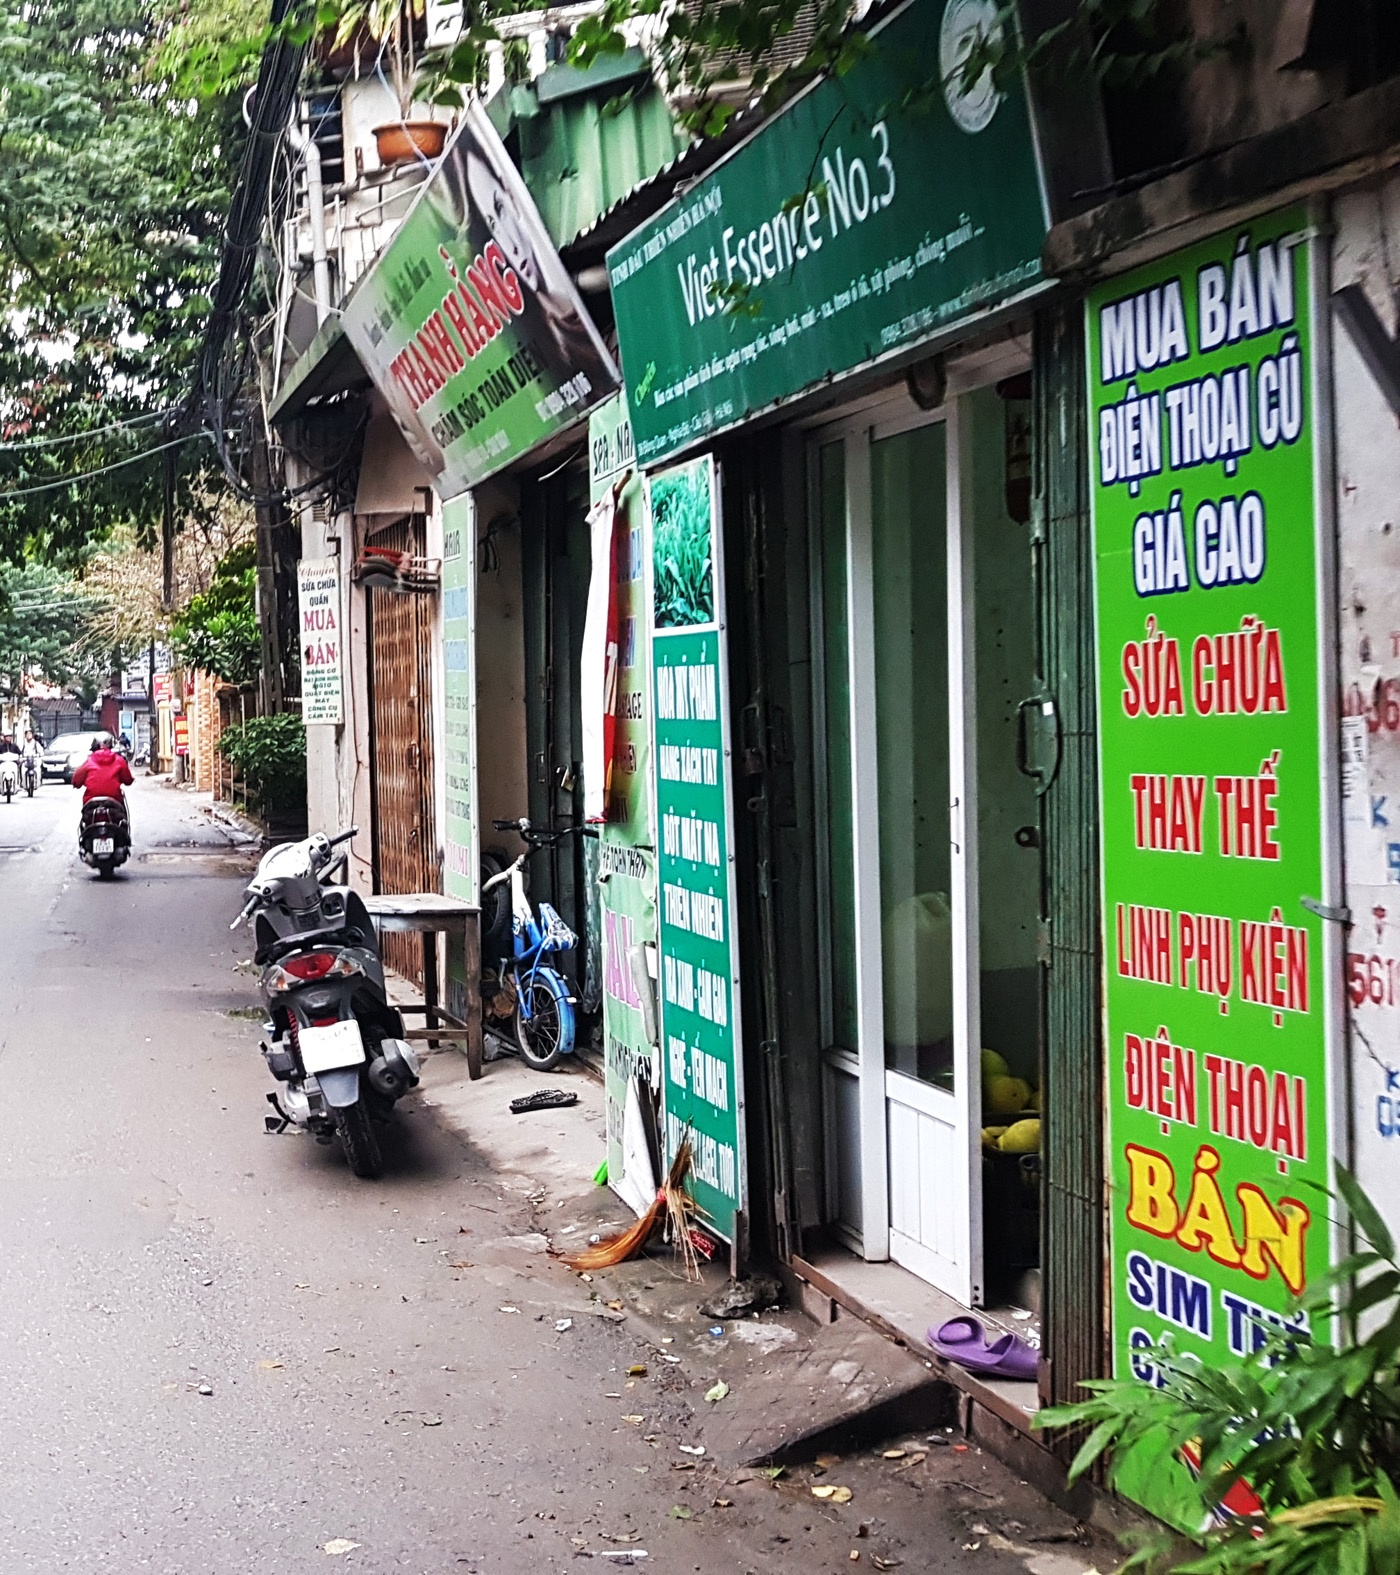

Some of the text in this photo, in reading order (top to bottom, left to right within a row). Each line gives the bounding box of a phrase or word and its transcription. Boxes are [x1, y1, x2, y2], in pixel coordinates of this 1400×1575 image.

[677, 246, 725, 327] Viet
[822, 120, 896, 239] No.3
[1101, 278, 1189, 385] MUA
[1198, 232, 1297, 354] BÁN
[389, 309, 467, 412] THANH
[457, 392, 486, 430] SÓC
[478, 365, 517, 412] TOÀN
[1100, 382, 1162, 496] ĐIỆN
[1165, 364, 1251, 476] THOẠI
[1133, 489, 1266, 598] GIÁ CAO
[303, 608, 336, 632] MUA
[304, 637, 335, 666] BÁN
[1122, 614, 1184, 718] SỬA
[1192, 614, 1288, 716] CHỮA
[688, 640, 716, 720] PHẨM
[702, 747, 717, 785] TAY
[1130, 750, 1281, 861] THAY THẾ
[681, 809, 702, 871] MẶT
[664, 877, 723, 942] THIÊN NHIÊN
[1116, 903, 1310, 1027] LINH PHỤ KIỆN
[1124, 1026, 1307, 1174] ĐIỆN THOẠI
[1126, 1143, 1309, 1296] BÁN
[1126, 1250, 1212, 1342] SIM
